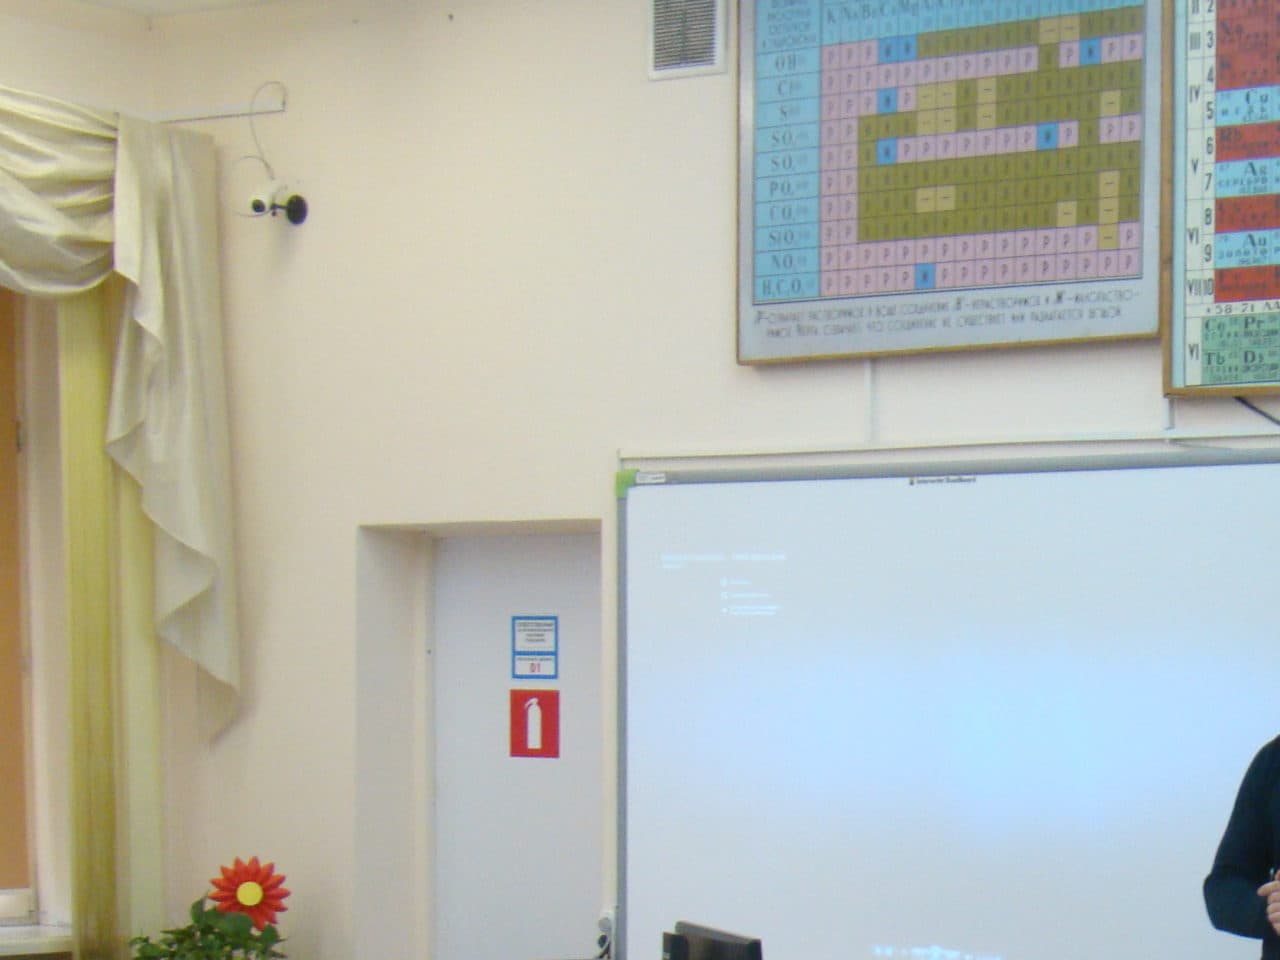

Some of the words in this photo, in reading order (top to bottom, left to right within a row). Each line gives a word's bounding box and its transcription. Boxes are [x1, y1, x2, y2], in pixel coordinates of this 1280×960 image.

[1206, 30, 1214, 49] 3
[1206, 65, 1214, 82] 4
[1206, 101, 1214, 120] 5
[1206, 136, 1214, 155] 6
[1205, 172, 1213, 191] 7
[1204, 208, 1212, 225] 8
[1187, 229, 1200, 246] VI
[1204, 244, 1212, 263] 9
[1242, 234, 1268, 248] Au
[1244, 316, 1265, 329] Pr
[1205, 351, 1226, 365] Tb
